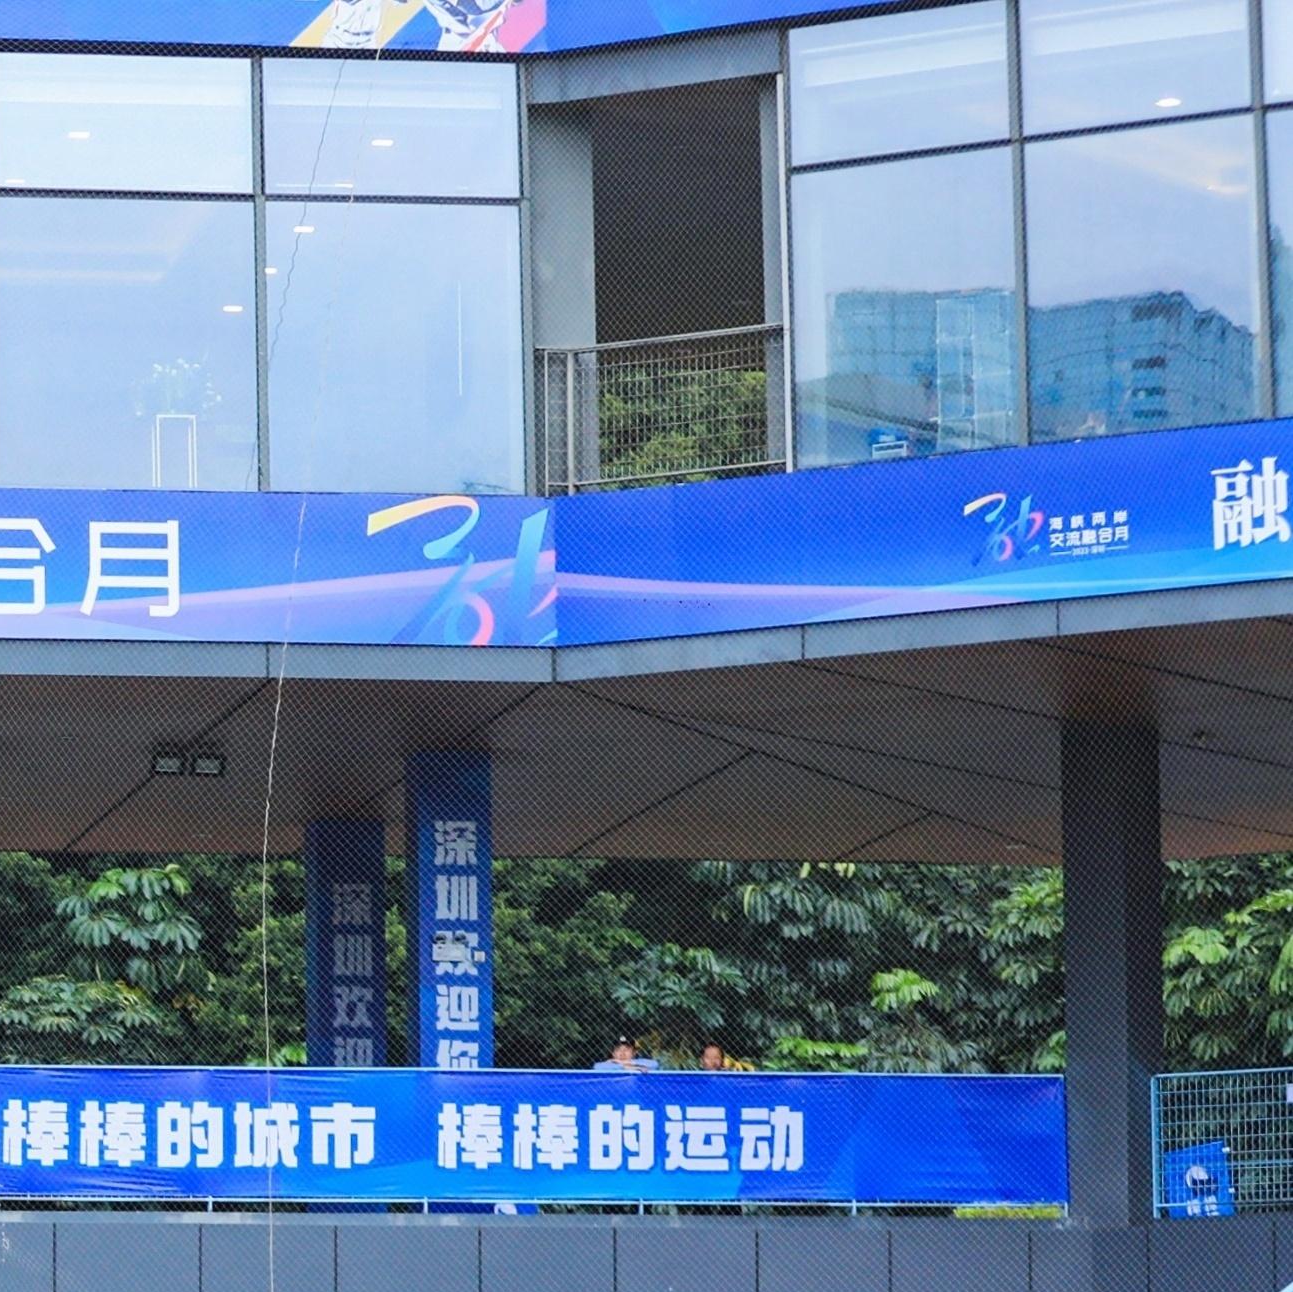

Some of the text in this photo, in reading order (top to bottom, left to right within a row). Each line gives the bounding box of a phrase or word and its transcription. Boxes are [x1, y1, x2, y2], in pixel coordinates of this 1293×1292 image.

[1049, 525, 1129, 548] 交流融合月
[1210, 455, 1292, 551] 融
[1, 1099, 805, 1172] 棒棒的城市 棒棒的运动
